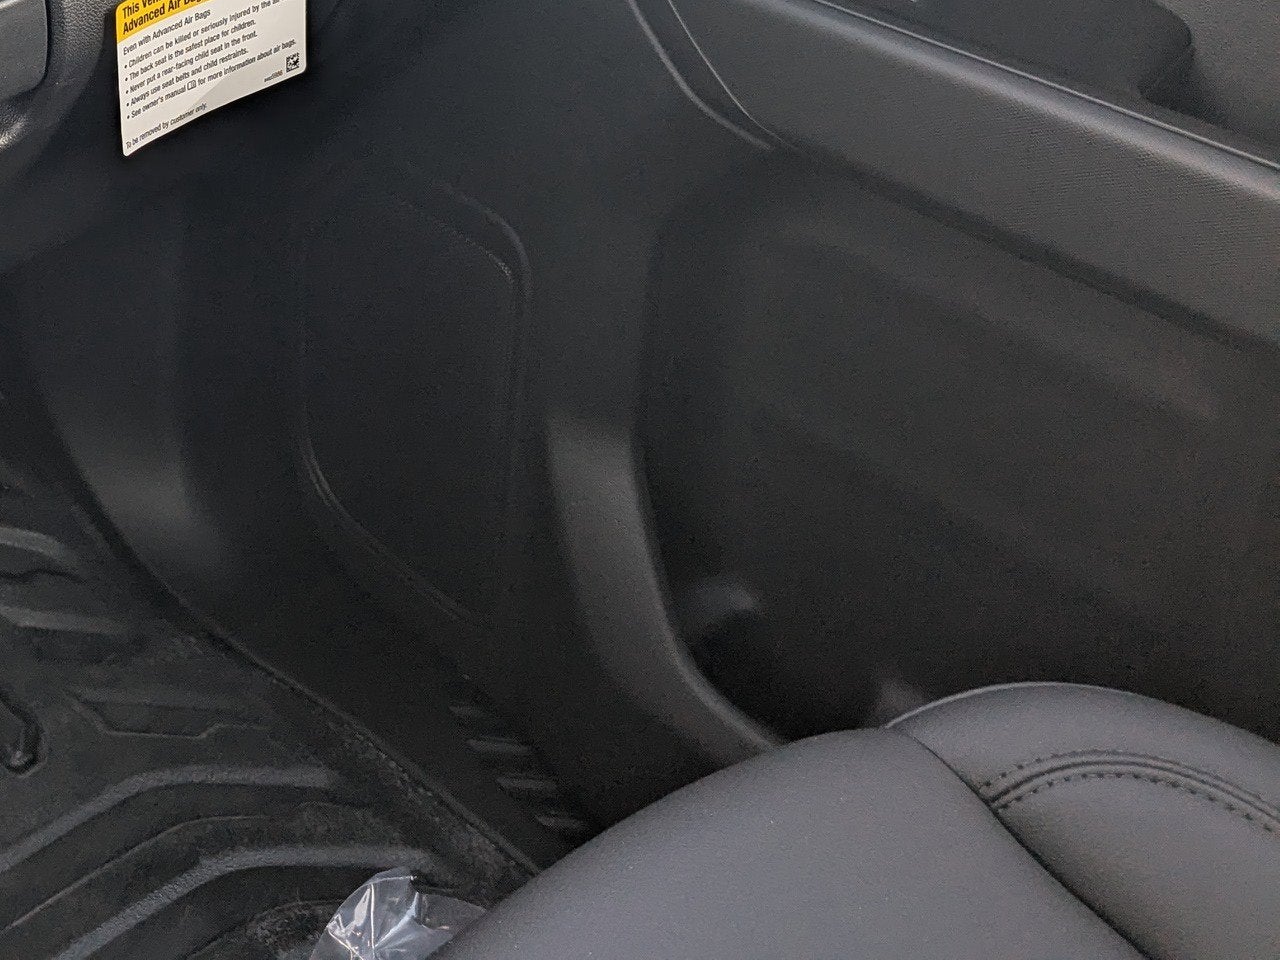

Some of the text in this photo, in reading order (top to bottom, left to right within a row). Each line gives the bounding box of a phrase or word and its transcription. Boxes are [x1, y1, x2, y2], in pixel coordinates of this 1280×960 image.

[122, 2, 140, 19] This
[123, 3, 165, 34] Advanced
[123, 9, 211, 56] Even with Advanced Air Bags
[129, 51, 152, 67] Children
[153, 45, 164, 55] can
[165, 41, 173, 49] be
[175, 32, 191, 44] killed
[193, 29, 199, 37] or
[201, 17, 228, 34] seriously
[230, 7, 250, 22] injured
[252, 4, 260, 13] by
[261, 0, 271, 9] the
[129, 71, 139, 80] The
[140, 63, 153, 74] back
[155, 55, 167, 67] seat
[175, 48, 184, 58] the
[185, 40, 203, 53] safest
[204, 33, 220, 46] place
[221, 29, 229, 37] for
[231, 19, 256, 34] children.
[130, 80, 145, 93] Never
[147, 74, 156, 85] put
[195, 50, 209, 61] child
[210, 44, 223, 55] seat
[231, 37, 240, 46] the
[242, 30, 257, 43] front.
[131, 109, 141, 118] See
[142, 96, 164, 112] owner's
[165, 85, 186, 100] manual
[198, 78, 206, 86] for
[207, 70, 222, 81] more
[257, 49, 272, 61] about
[282, 39, 296, 50] bags.
[131, 91, 149, 106] Always
[150, 86, 160, 94] use
[162, 78, 174, 89] seat
[176, 71, 190, 82] belts
[191, 66, 202, 76] and
[203, 59, 217, 71] child
